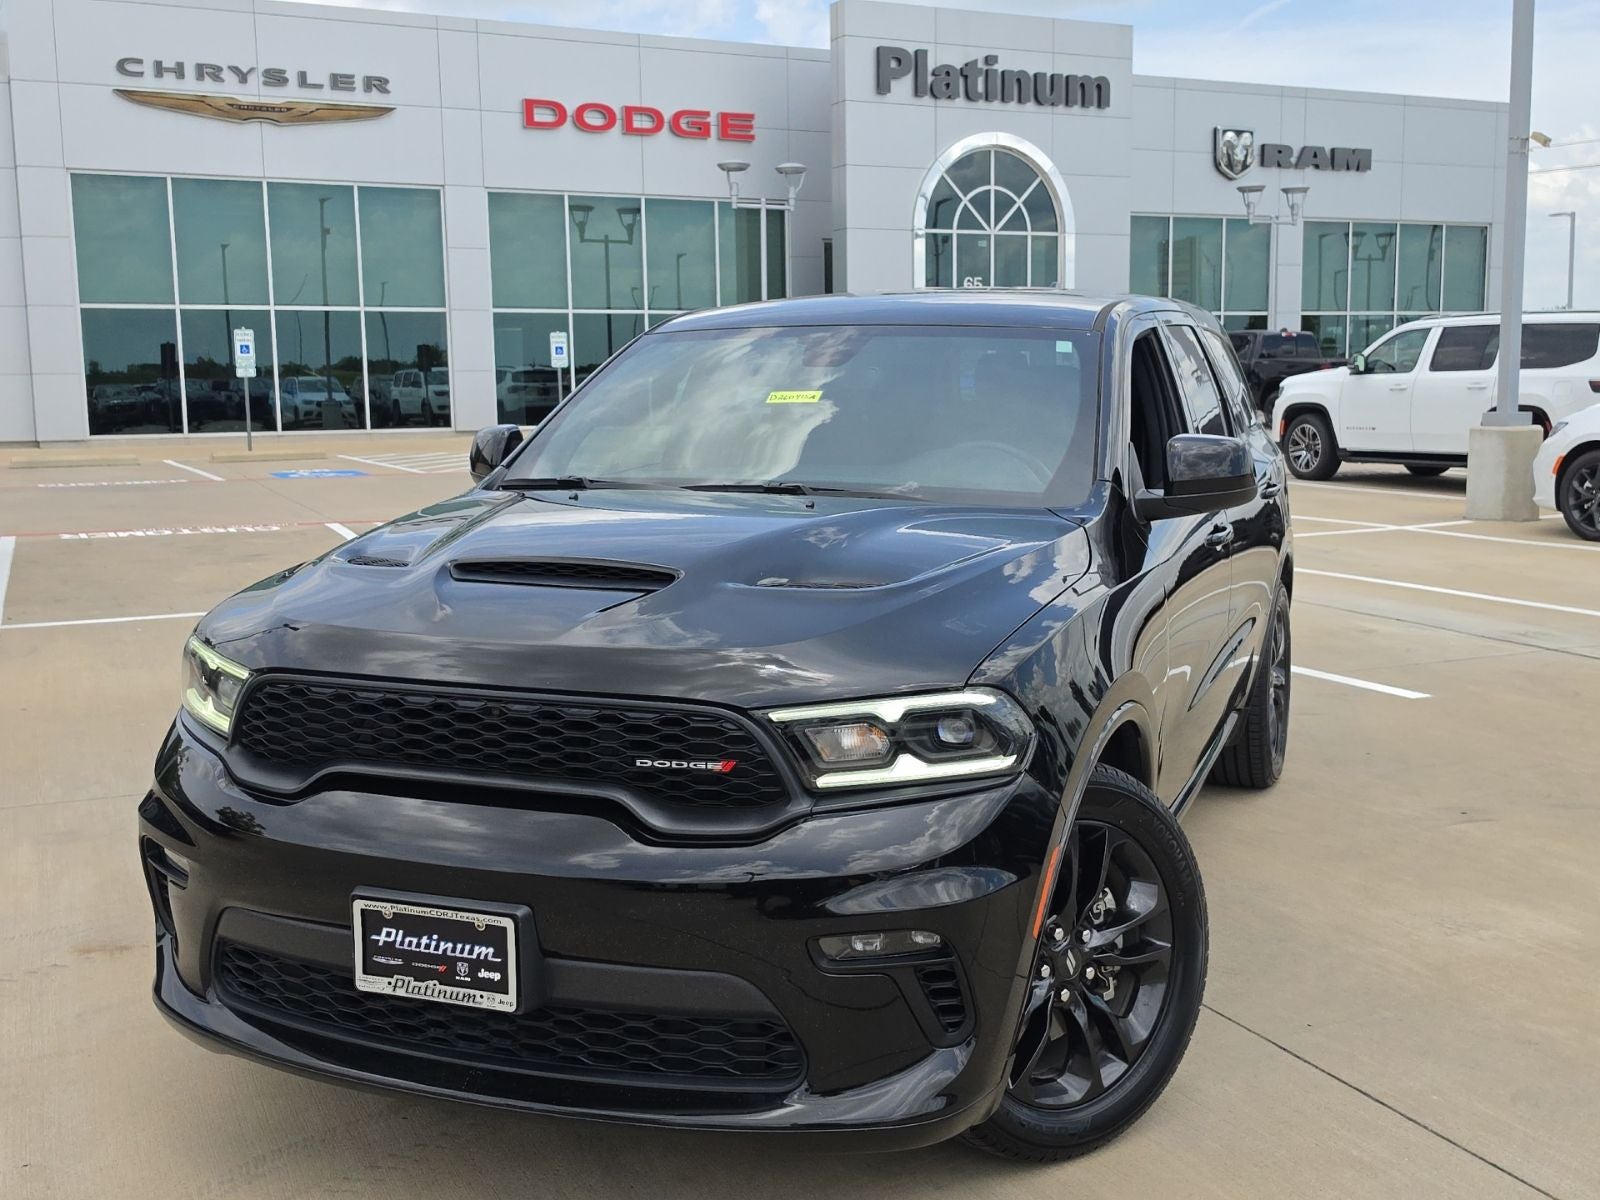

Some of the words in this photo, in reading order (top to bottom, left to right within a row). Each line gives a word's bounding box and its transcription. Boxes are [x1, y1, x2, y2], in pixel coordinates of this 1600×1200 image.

[115, 57, 392, 95] CHRYSLER
[876, 45, 1111, 110] Platinum
[522, 98, 756, 142] DODGE
[1260, 143, 1373, 172] RAM
[636, 759, 722, 770] DODGE
[370, 927, 502, 962] Platinum
[477, 968, 501, 982] Jeep
[392, 978, 482, 1005] Platinum
[498, 998, 514, 1007] Jeep
